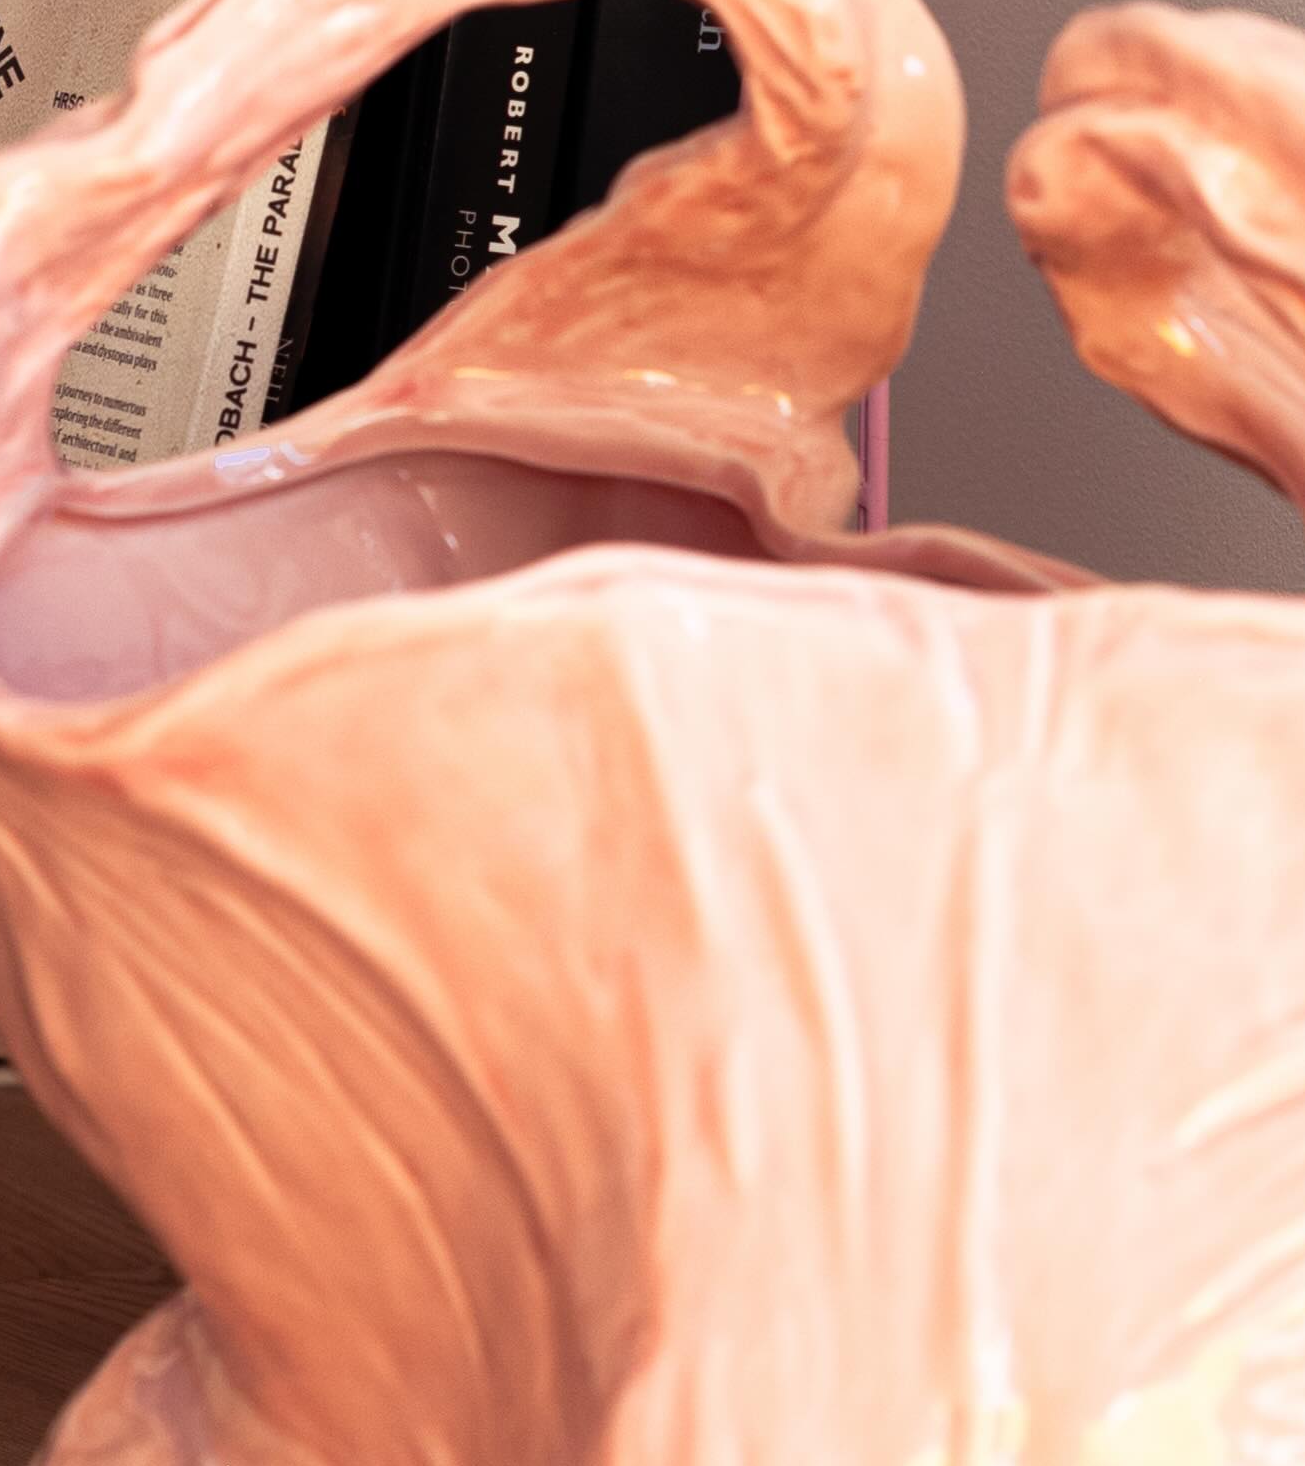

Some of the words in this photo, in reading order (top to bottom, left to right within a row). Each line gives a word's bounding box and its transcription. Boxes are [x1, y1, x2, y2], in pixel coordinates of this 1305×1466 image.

[498, 46, 534, 194] ROBERT
[262, 134, 303, 236] PARA
[446, 209, 477, 308] PHOT
[246, 244, 279, 304] THE
[134, 283, 146, 295] as
[147, 284, 173, 302] three
[149, 308, 168, 325] this
[95, 343, 134, 365] dystopia
[132, 353, 157, 372] plays
[59, 382, 93, 404] journey
[87, 413, 103, 429] the
[101, 417, 142, 439] different
